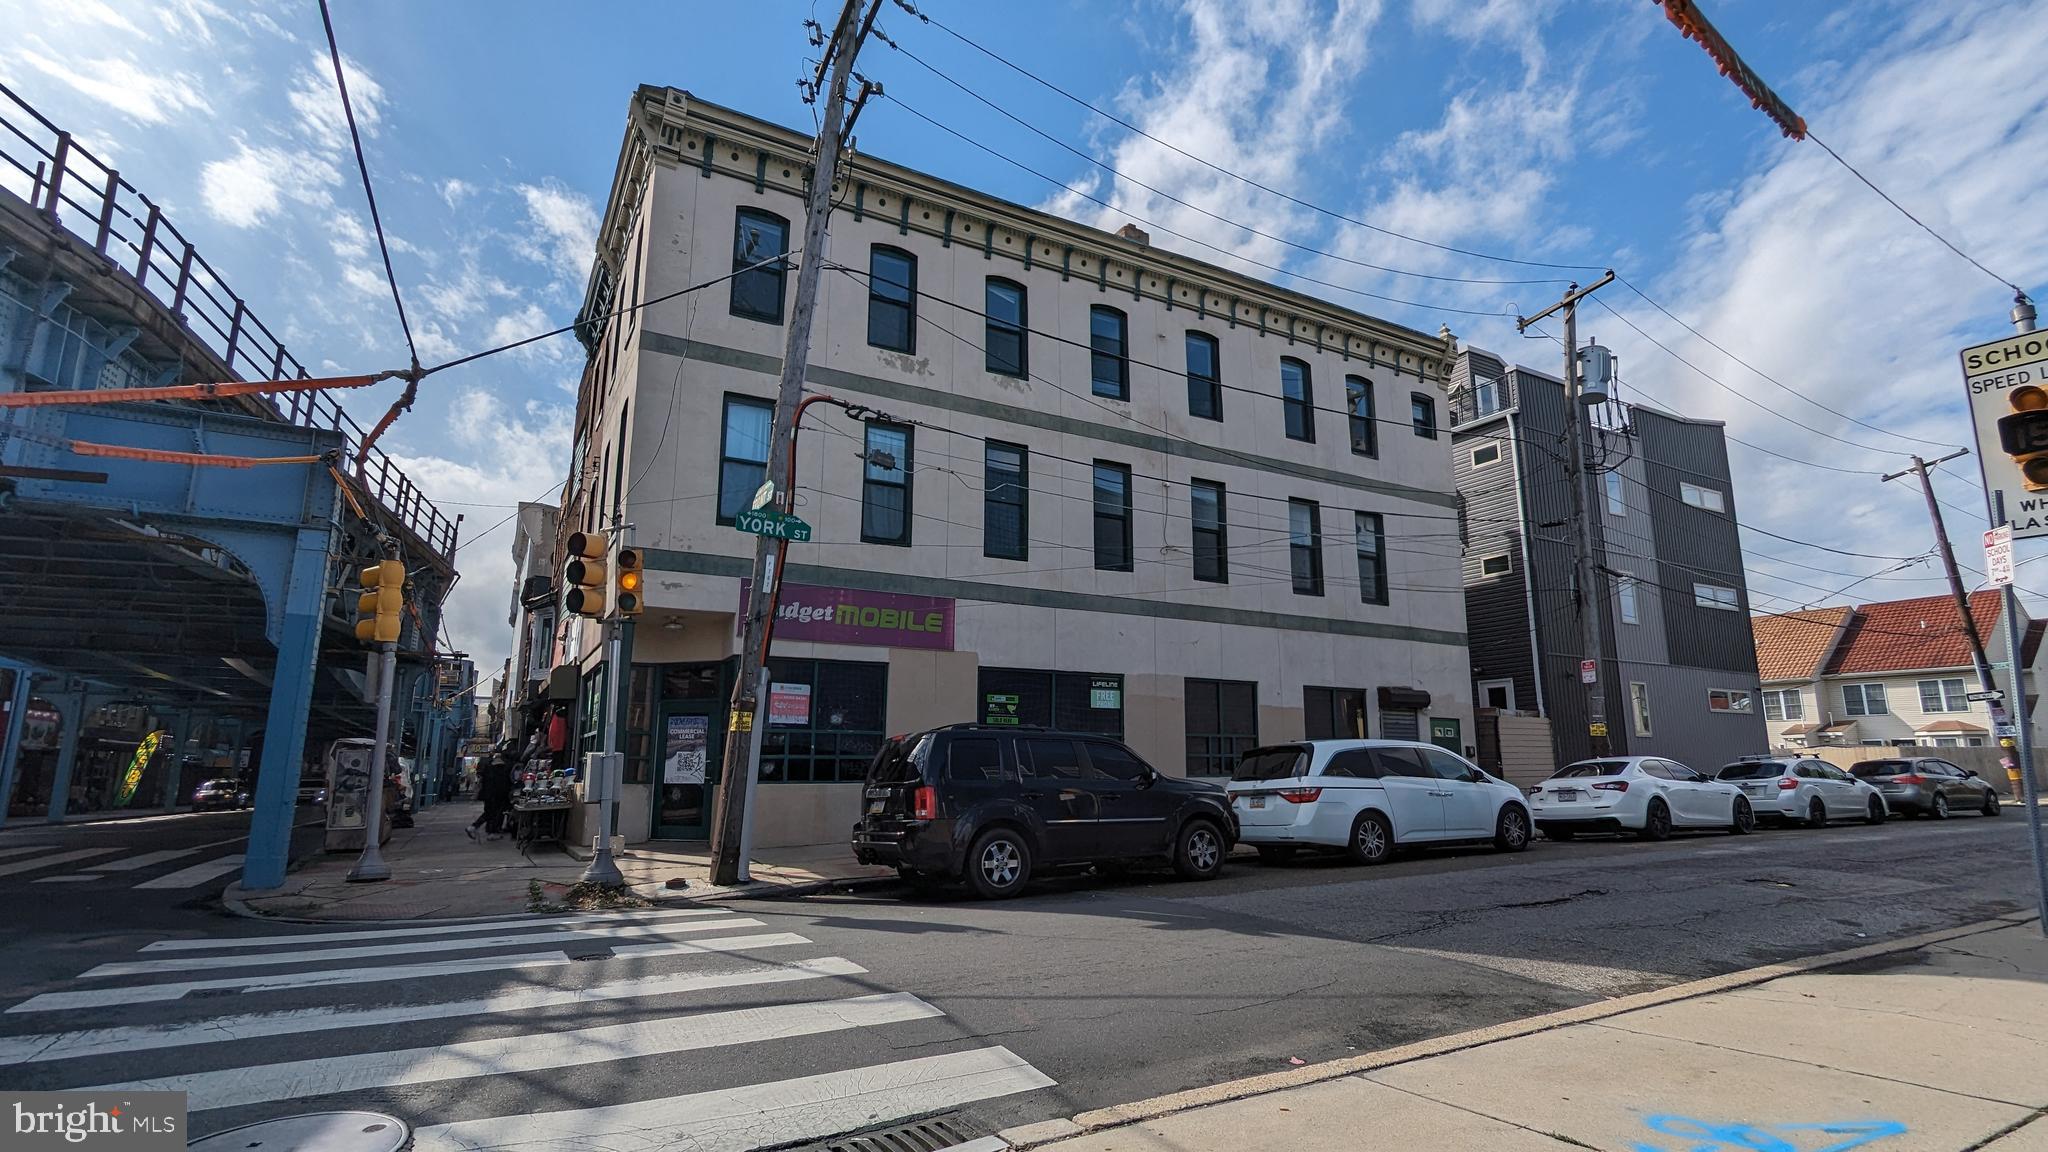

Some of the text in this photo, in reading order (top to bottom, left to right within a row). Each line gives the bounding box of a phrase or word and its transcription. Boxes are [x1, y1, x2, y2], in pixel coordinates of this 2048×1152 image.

[1967, 339, 2048, 370] SCHO
[1972, 371, 2030, 394] SPEED
[740, 515, 808, 539] YORK ST
[1984, 533, 1993, 547] NO
[1986, 545, 2010, 557] SCHOOL
[1992, 555, 2007, 566] DAYS
[835, 604, 943, 632] MOBILE
[1096, 690, 1115, 700] FREE
